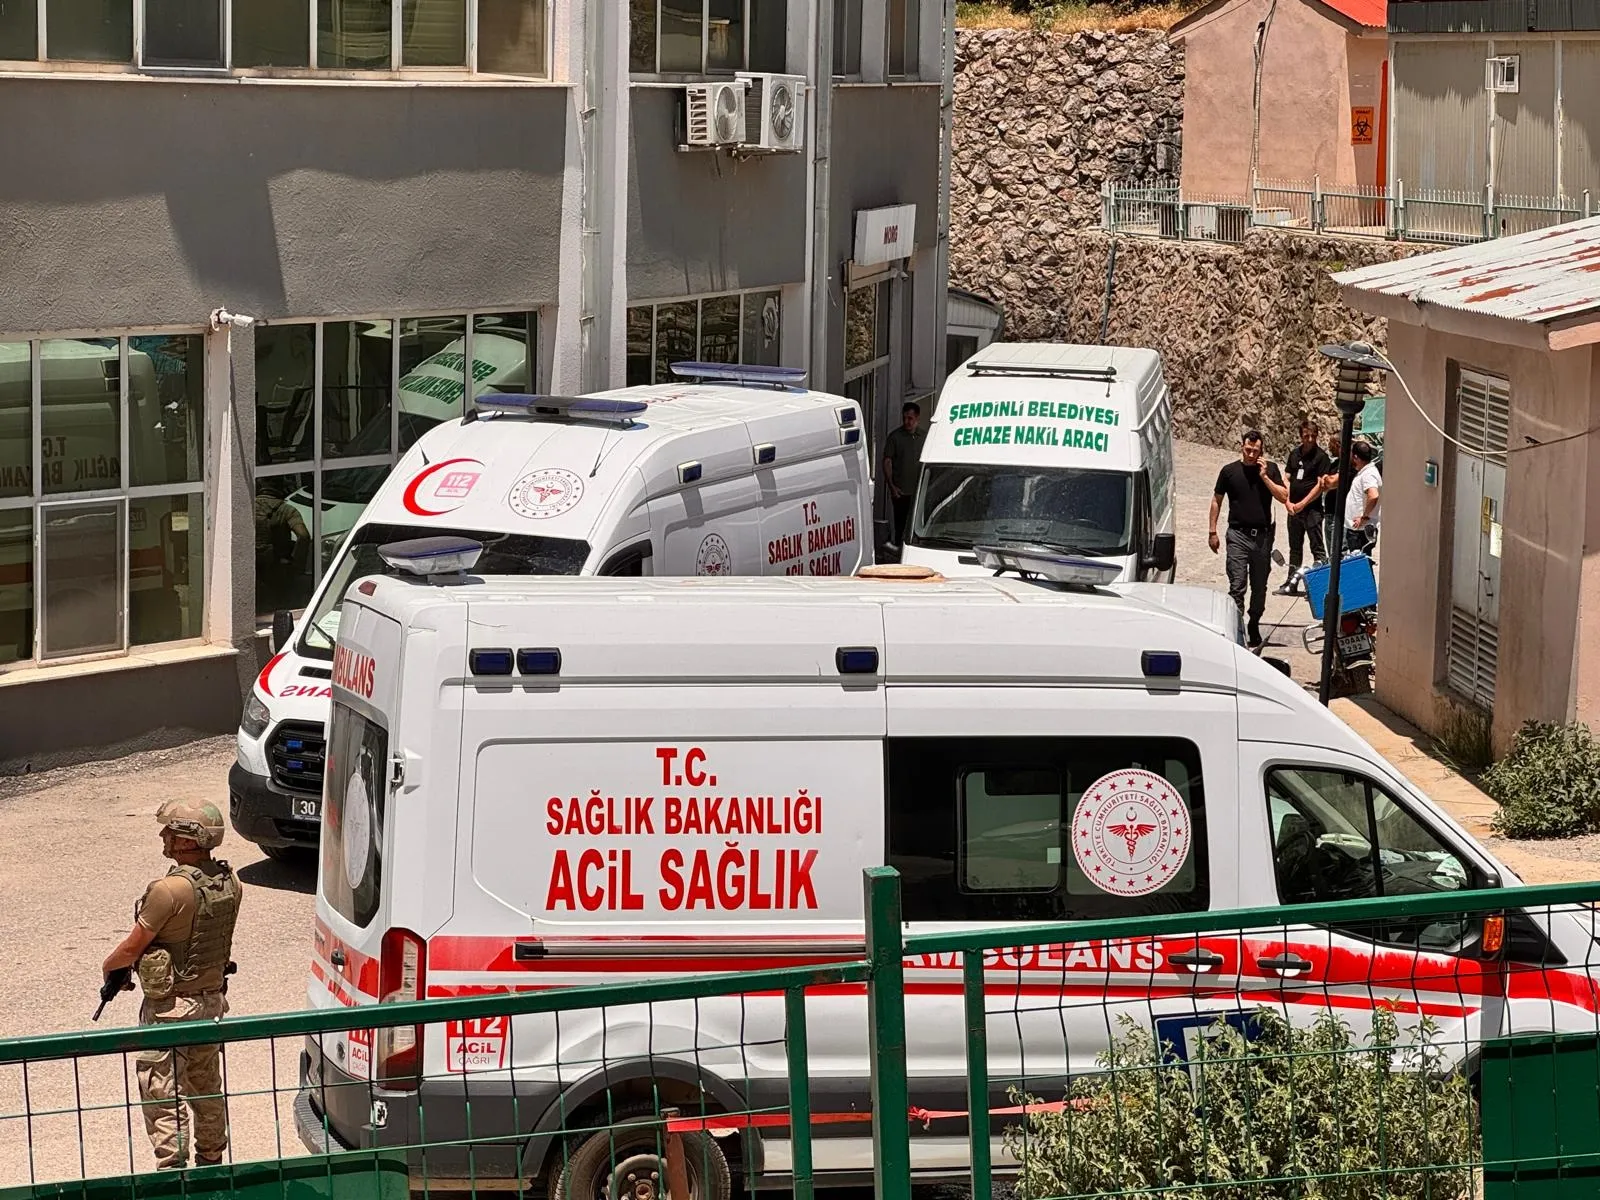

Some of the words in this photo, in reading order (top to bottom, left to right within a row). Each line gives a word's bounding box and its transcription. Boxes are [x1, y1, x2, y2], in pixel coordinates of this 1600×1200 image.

[953, 426, 1012, 446] CENAZE
[1062, 428, 1109, 452] ARACI
[446, 474, 473, 487] 112
[803, 501, 821, 526] T.C.
[768, 534, 803, 565] SAĞLIK
[808, 516, 855, 554] BAKANLIĞI
[656, 747, 717, 786] T.C.
[300, 800, 316, 815] 30
[546, 789, 655, 835] SAĞLIK
[665, 789, 822, 835] BAKANLIĞI
[1096, 793, 1138, 831] CUMHURİYETİ
[1140, 795, 1163, 818] SAĞLIK
[1149, 820, 1168, 865] BAKANLIĞI
[658, 841, 819, 911] SAĞLIK
